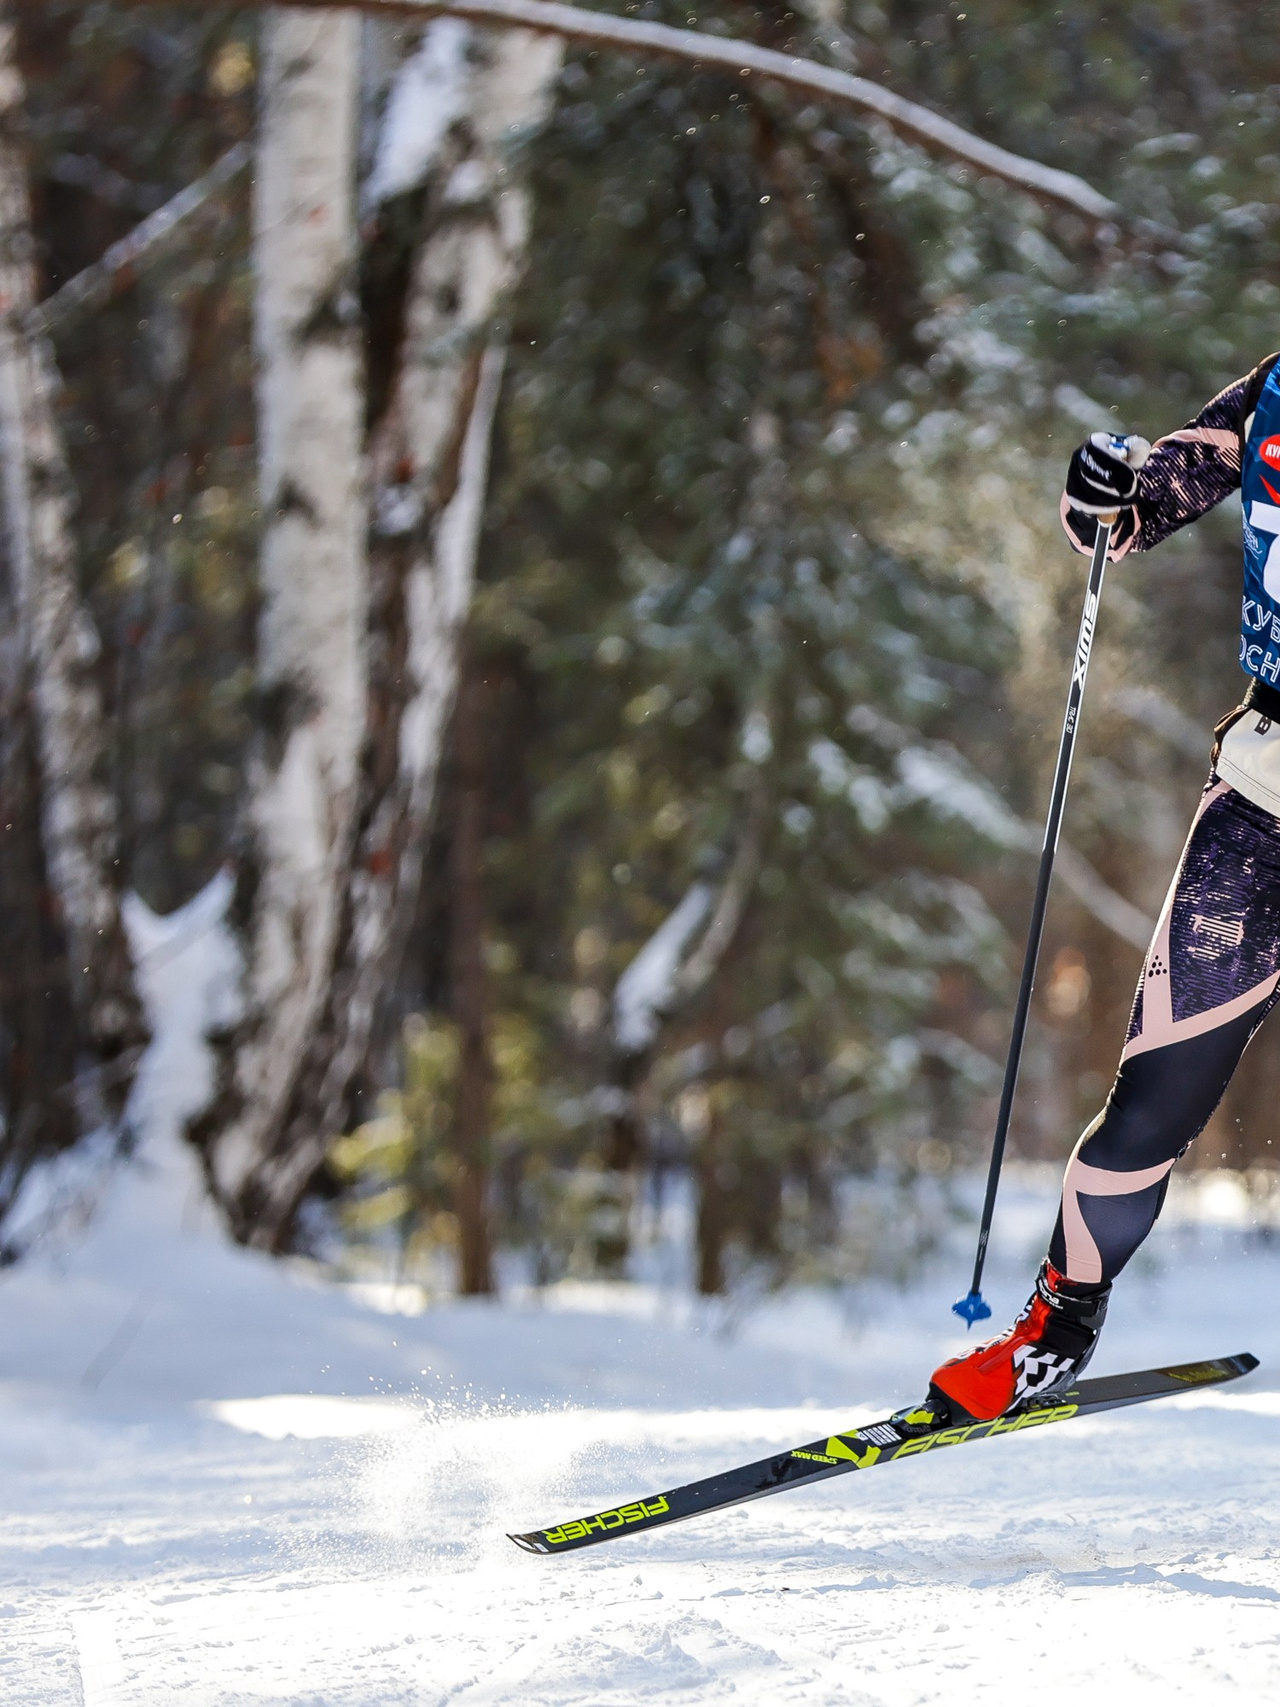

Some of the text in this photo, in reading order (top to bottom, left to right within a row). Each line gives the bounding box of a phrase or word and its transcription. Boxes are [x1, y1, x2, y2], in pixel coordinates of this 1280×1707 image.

[890, 1404, 1079, 1460] FISCHER
[791, 1450, 811, 1459] MAX
[812, 1454, 837, 1464] SPEED
[541, 1495, 670, 1544] FISCHER
